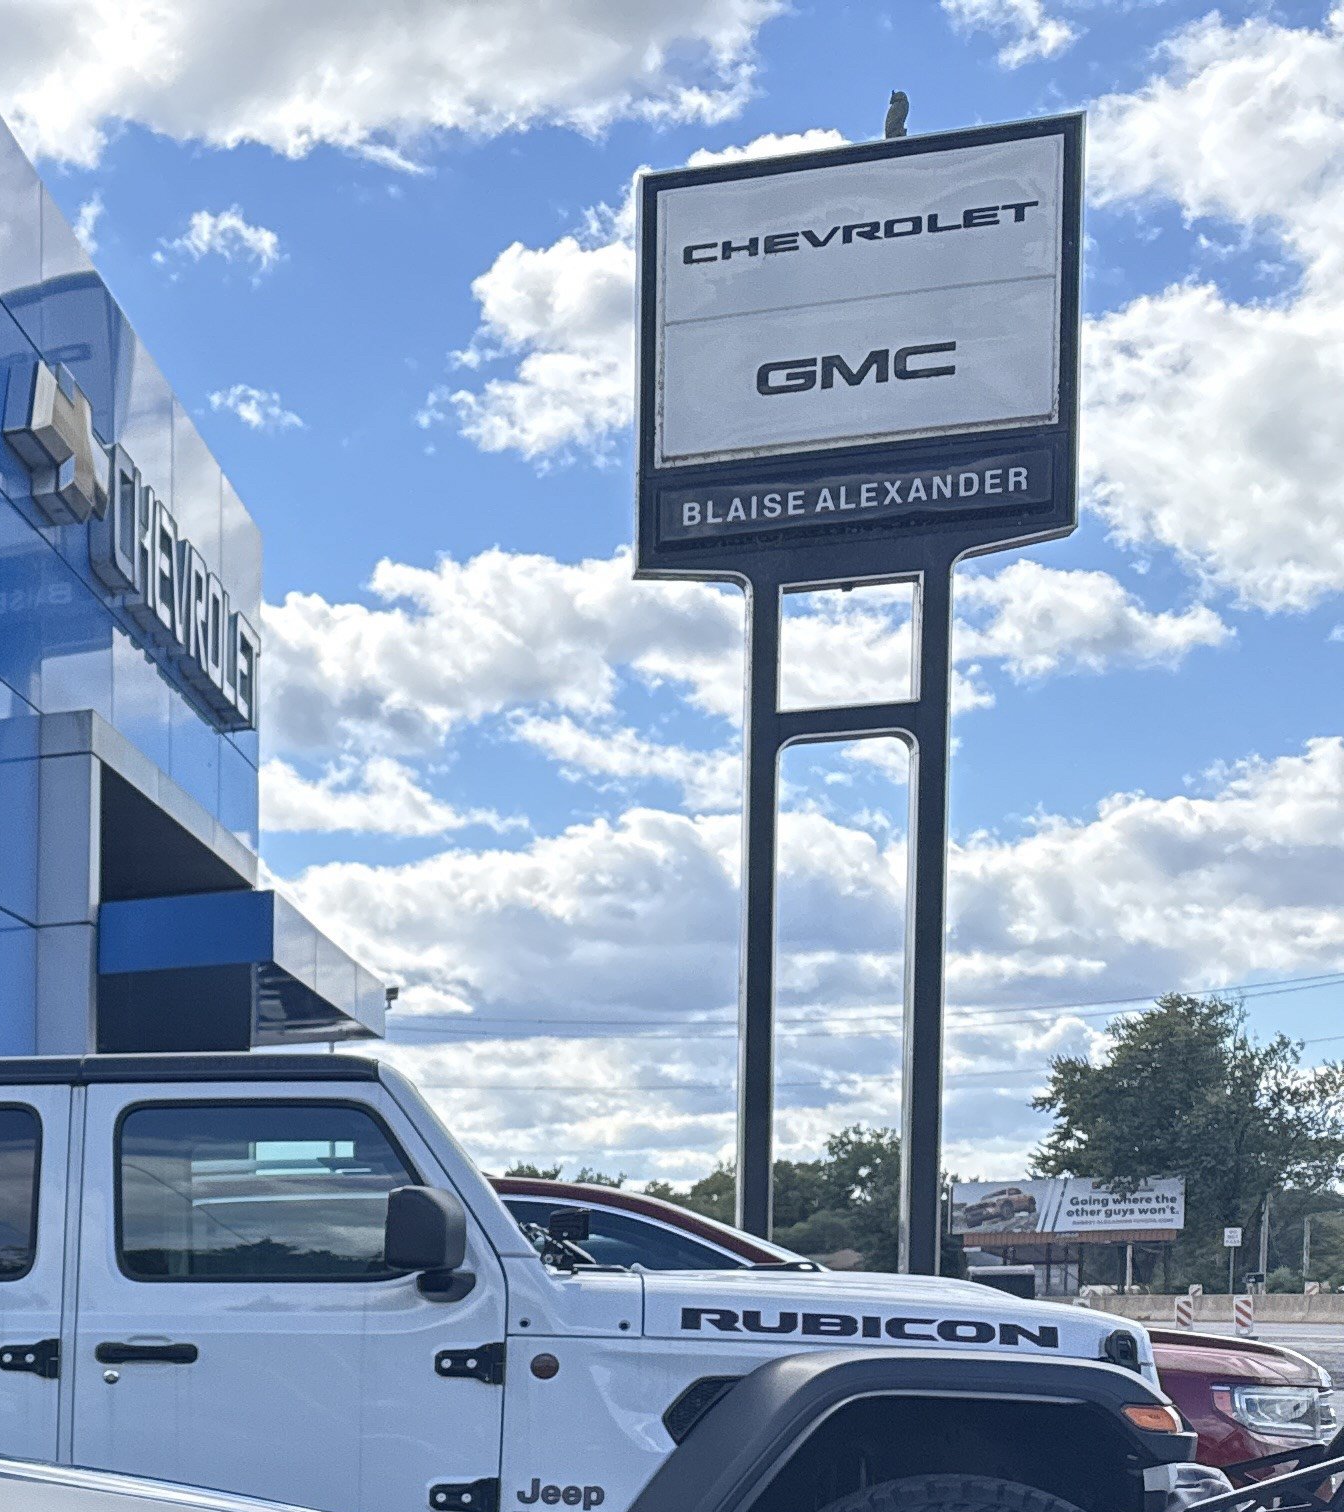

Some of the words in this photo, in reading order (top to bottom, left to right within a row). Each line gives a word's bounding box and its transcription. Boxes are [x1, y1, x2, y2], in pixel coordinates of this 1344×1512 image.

[683, 201, 1039, 265] CHEVROLET
[756, 341, 957, 396] GMC
[682, 491, 805, 527] BLAISE
[815, 467, 1029, 514] ALEXANDER
[100, 443, 261, 732] CHEVROLET
[1066, 1207, 1102, 1217] other
[1104, 1207, 1135, 1219] guys
[1069, 1195, 1109, 1207] Going
[1112, 1194, 1153, 1204] where
[1155, 1194, 1177, 1204] the
[681, 1307, 1060, 1348] RUBICON
[517, 1478, 605, 1511] Jeep
